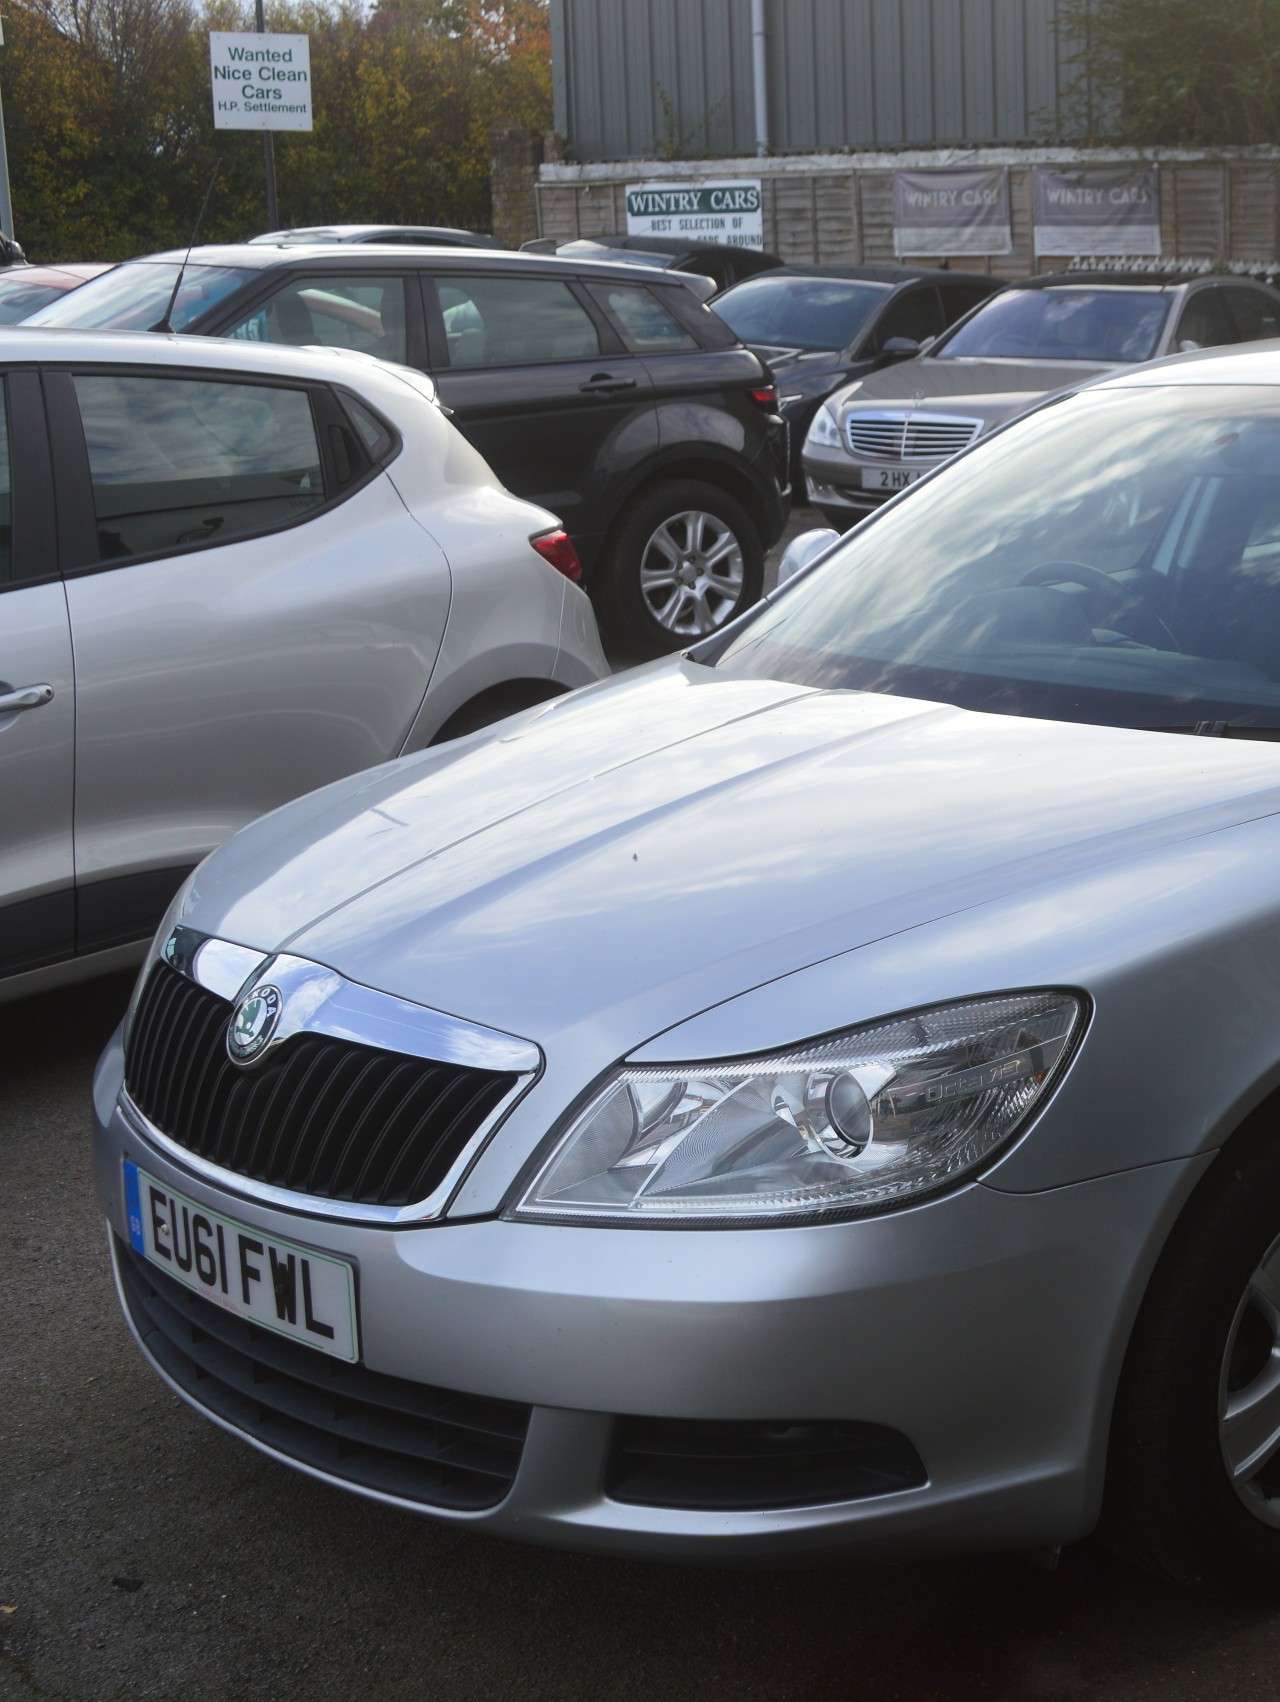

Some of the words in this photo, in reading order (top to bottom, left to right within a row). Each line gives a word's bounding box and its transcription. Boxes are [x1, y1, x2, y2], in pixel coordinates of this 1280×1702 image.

[228, 47, 293, 63] Wanted
[214, 65, 252, 80] Nice
[258, 66, 308, 82] Clean
[241, 84, 282, 100] Cars
[218, 101, 240, 112] H.P.
[243, 101, 307, 114] Settlement
[630, 191, 702, 213] WINTRY
[710, 189, 758, 210] CARS
[651, 219, 672, 232] BEST
[679, 218, 726, 231] SELECTION
[732, 217, 744, 229] OF
[150, 1185, 229, 1295] EU61
[238, 1233, 335, 1340] FWL
